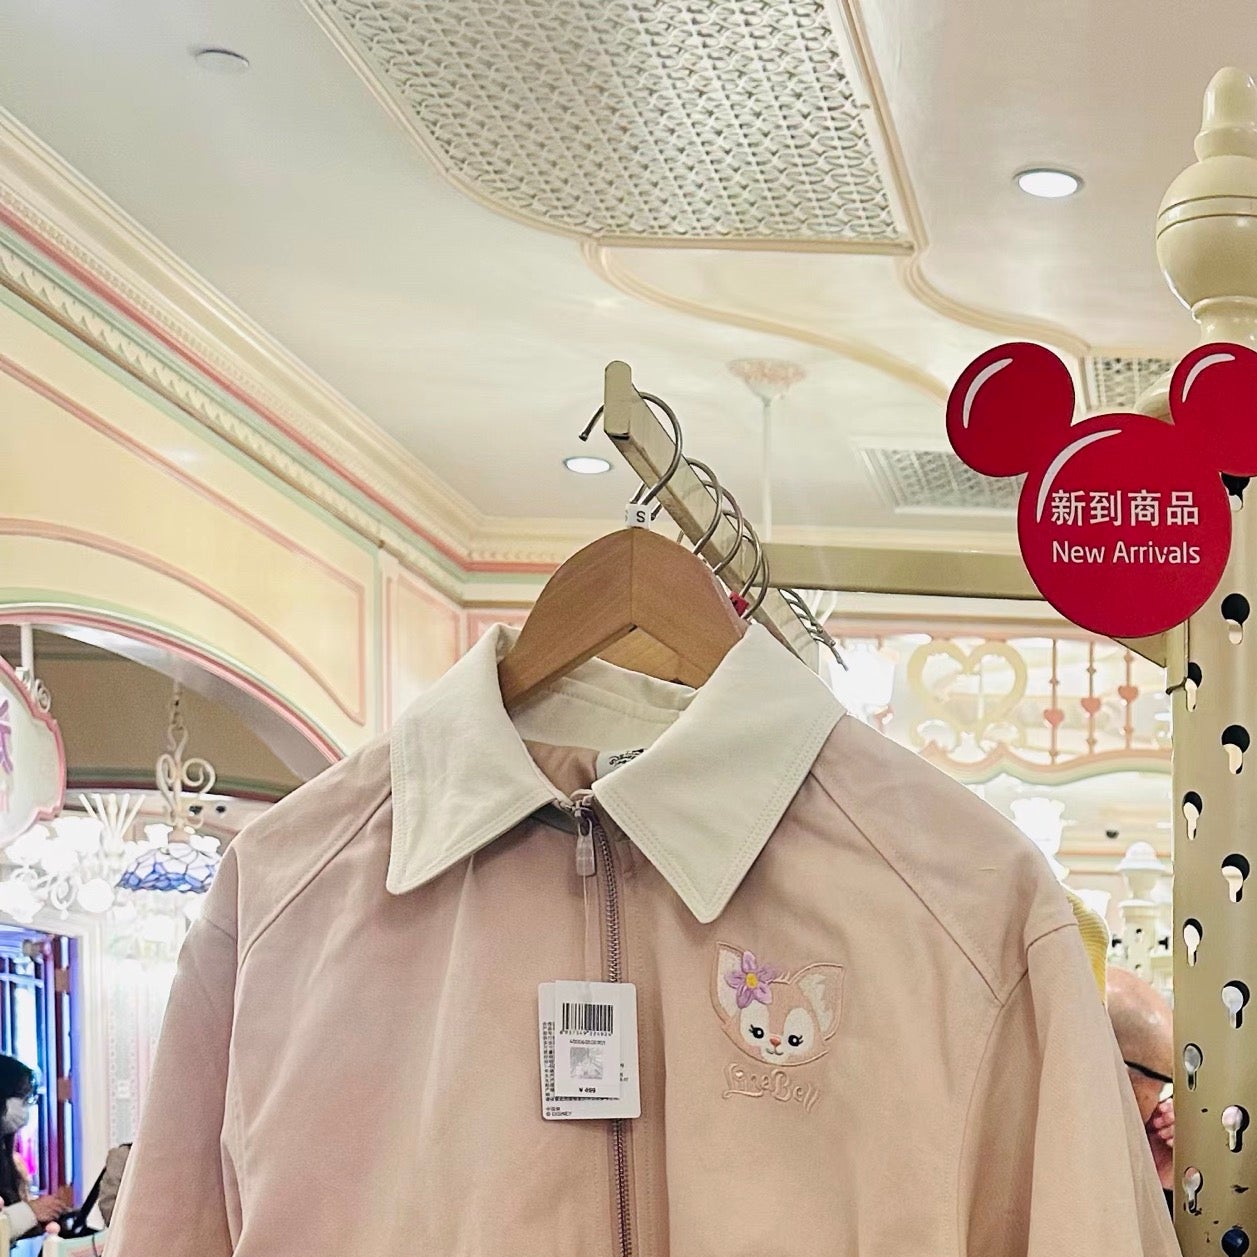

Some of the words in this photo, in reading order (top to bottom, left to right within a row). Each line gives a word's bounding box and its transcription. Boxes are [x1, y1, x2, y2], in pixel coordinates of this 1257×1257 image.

[636, 510, 646, 523] S
[1051, 490, 1199, 526] 新到商品
[1052, 541, 1105, 563] New
[1112, 540, 1201, 564] Arrivals
